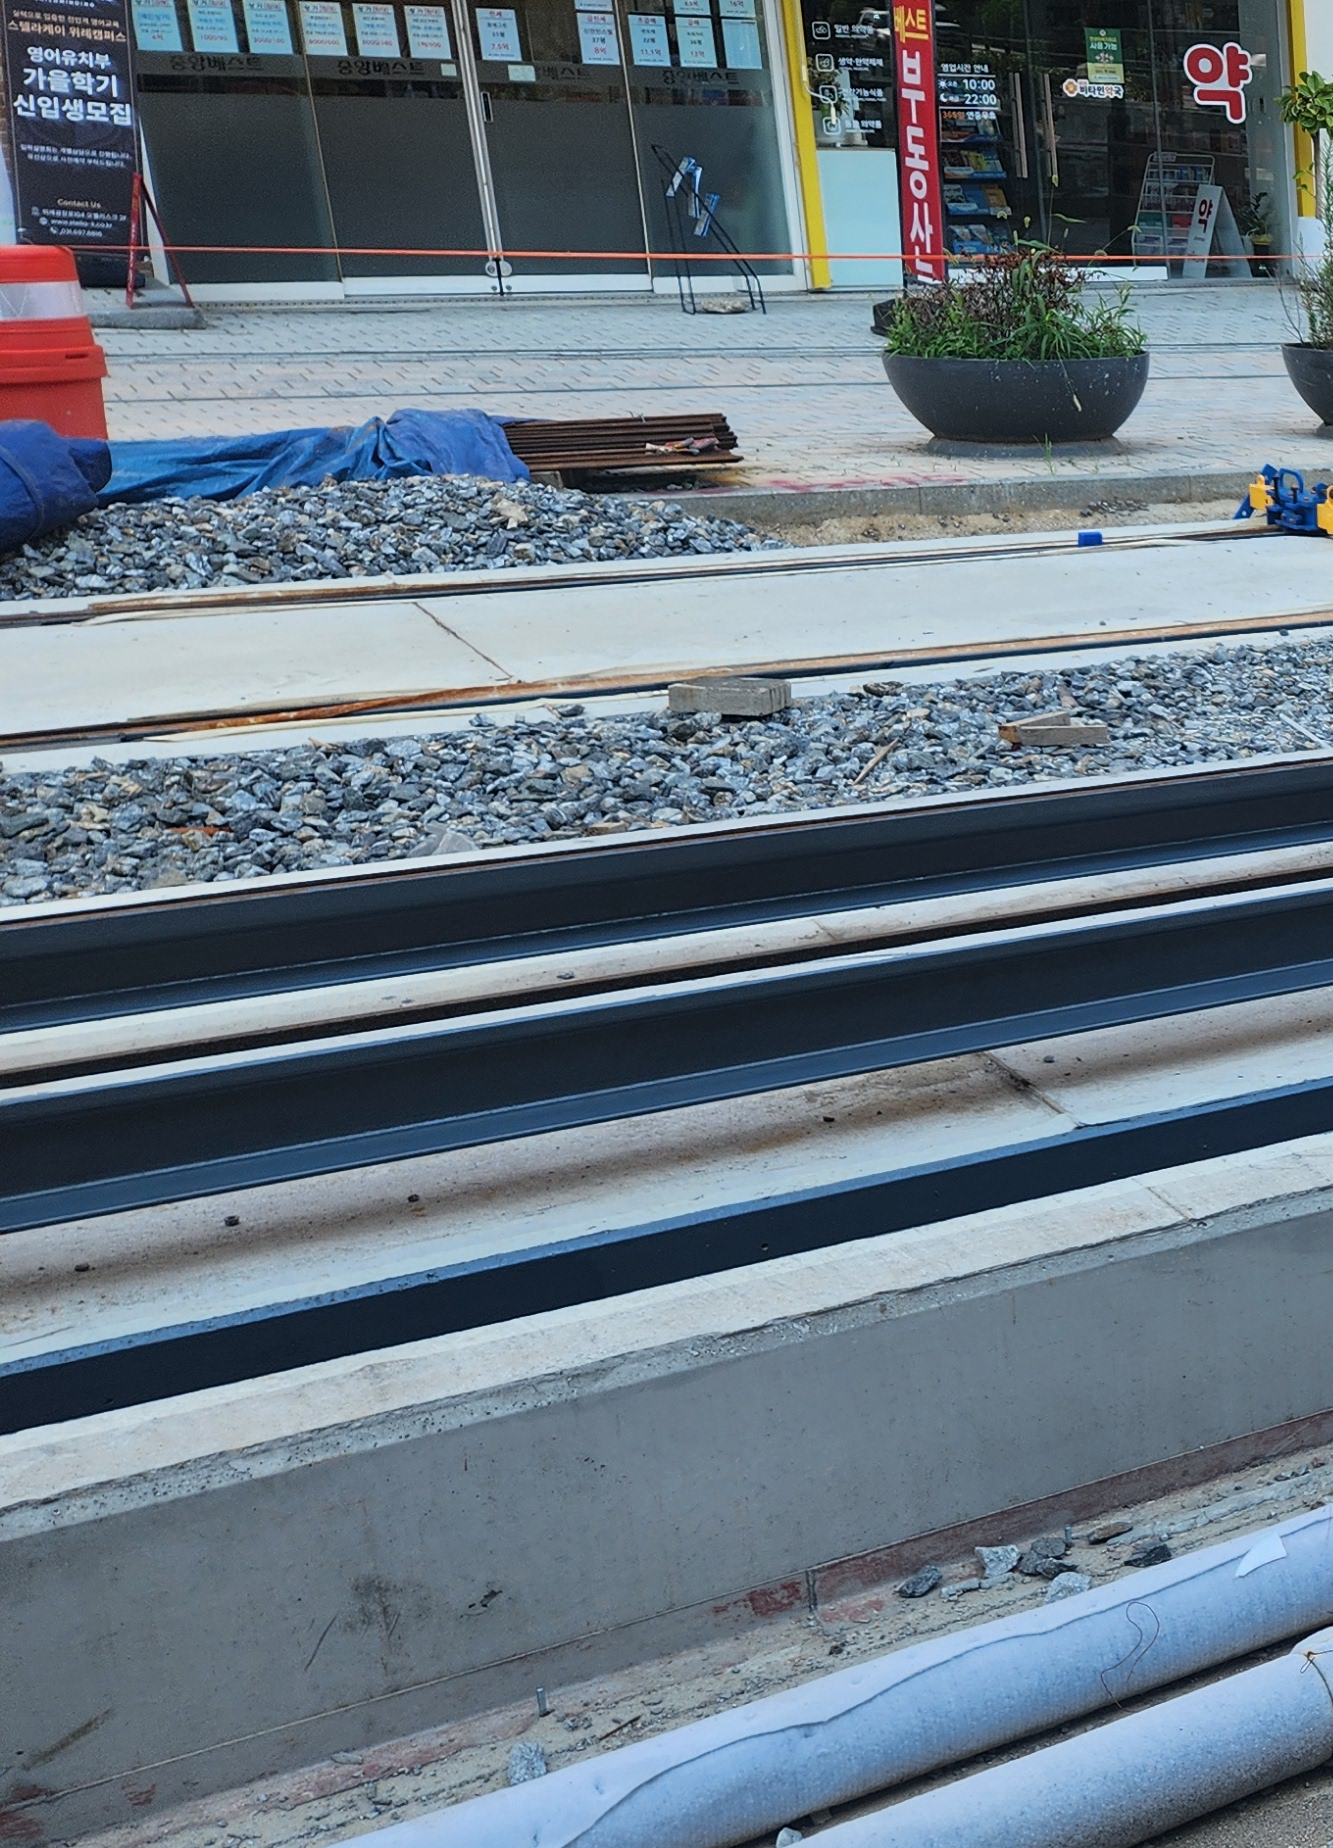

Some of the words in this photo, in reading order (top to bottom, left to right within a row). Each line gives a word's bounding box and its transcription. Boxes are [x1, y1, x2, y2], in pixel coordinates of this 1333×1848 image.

[26, 46, 112, 70] 영어유치부
[941, 63, 971, 73] 영업시간
[972, 64, 989, 73] 안내
[23, 67, 118, 98] 가을학기
[962, 79, 996, 91] 10:00
[1186, 44, 1250, 121] 약
[13, 94, 132, 126] 신입생모집
[964, 94, 997, 105] 22:00
[57, 198, 88, 207] Contact
[1198, 198, 1213, 234] 약
